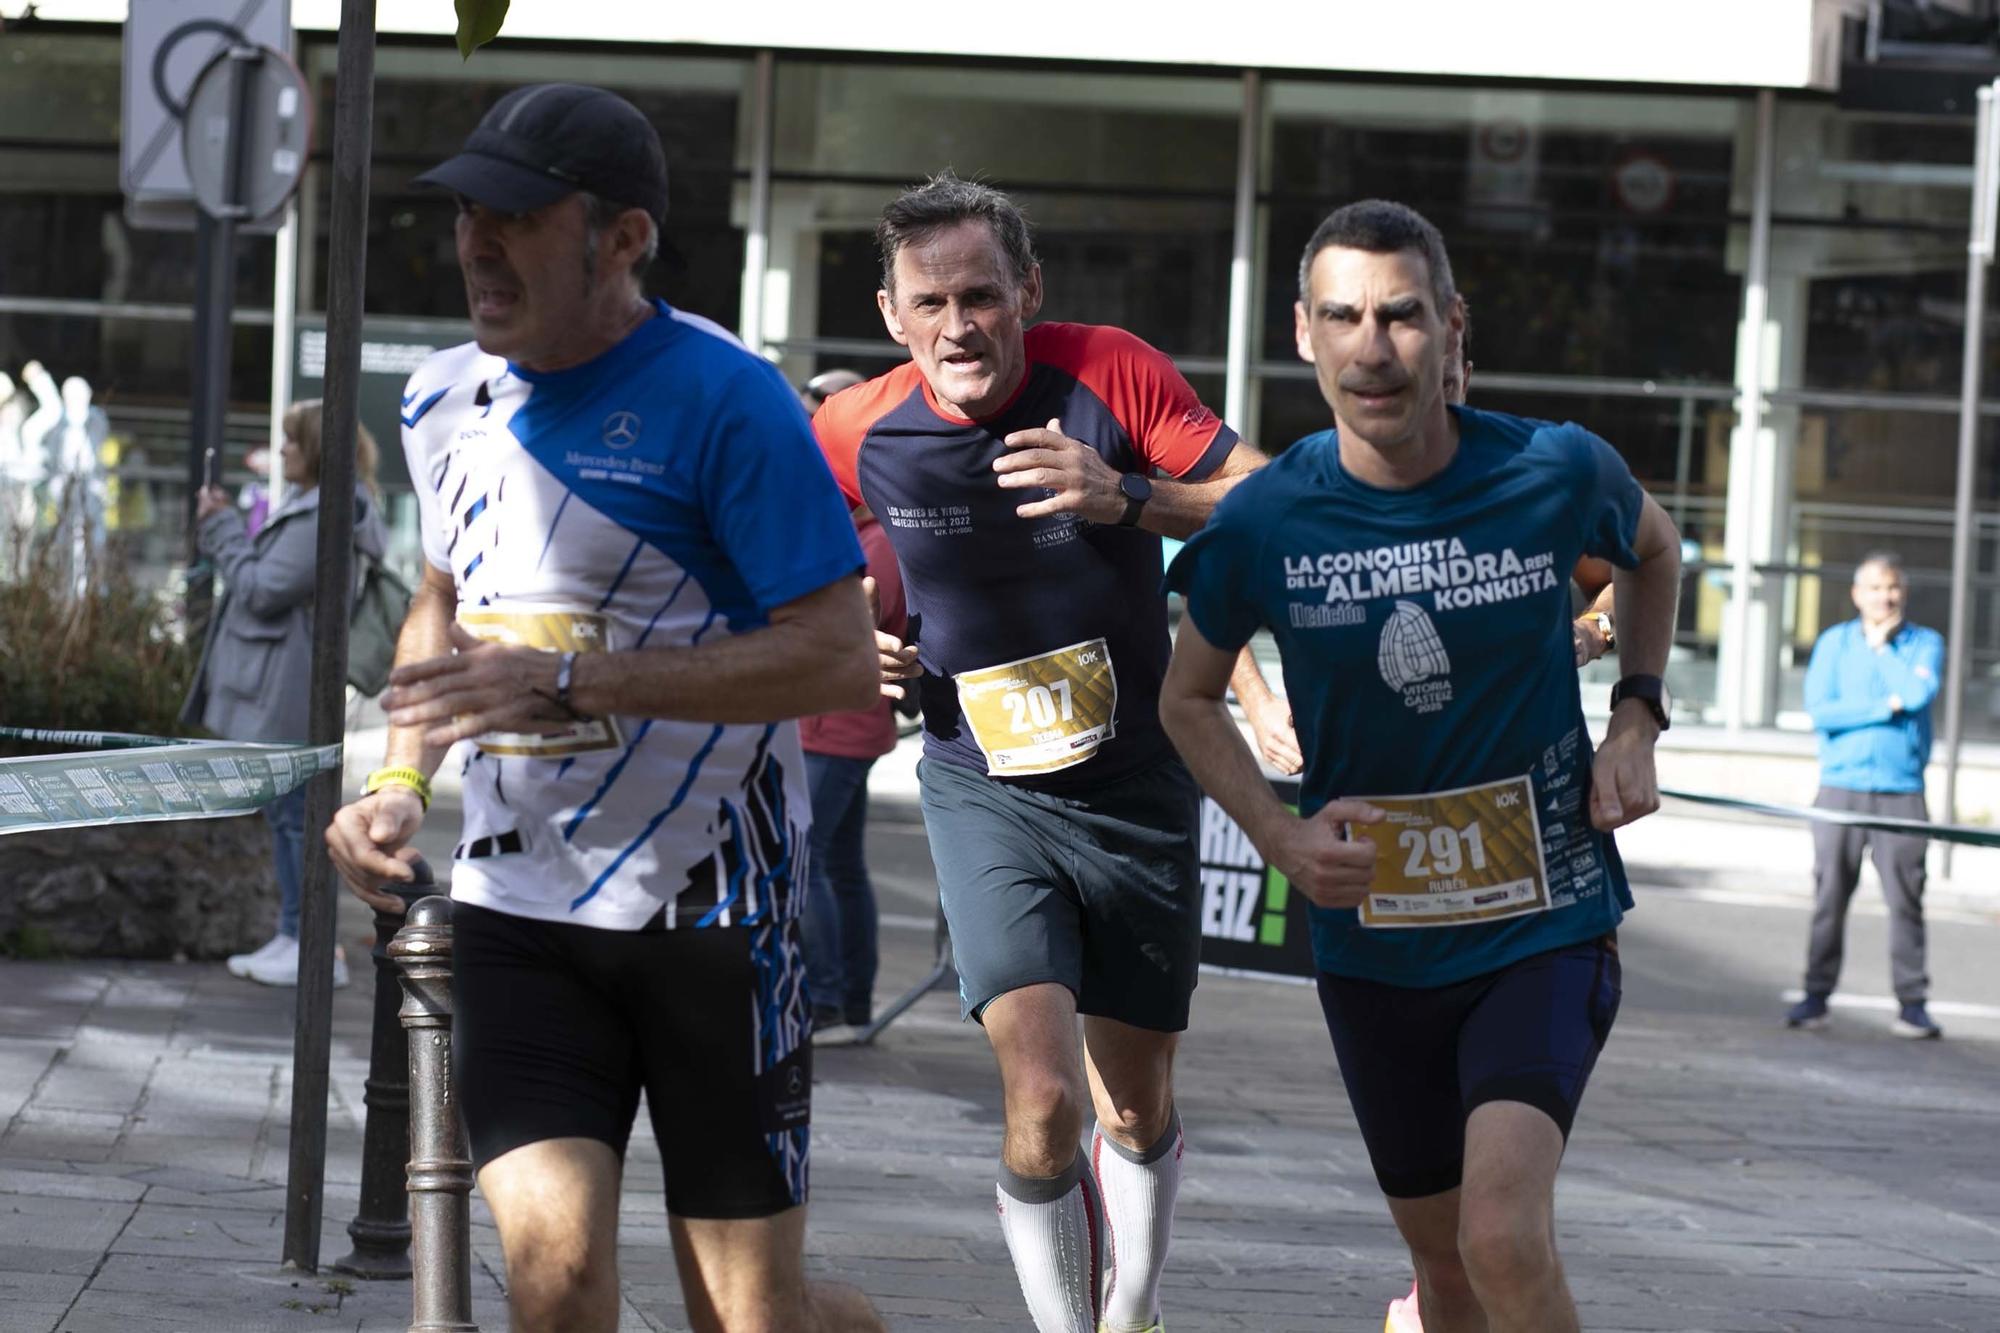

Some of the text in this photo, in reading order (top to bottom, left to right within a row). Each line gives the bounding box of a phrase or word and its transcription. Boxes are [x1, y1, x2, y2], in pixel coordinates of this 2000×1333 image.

[950, 516, 970, 527] 2022
[1284, 537, 1467, 576] LA CONQUISTA
[1286, 548, 1554, 604] DE LA ALMENDRA REN
[1434, 568, 1559, 612] KONKISTA
[1077, 650, 1099, 666] 10K
[1403, 680, 1452, 696] VITORIA
[1404, 690, 1454, 707] GASTEIZ
[1002, 678, 1074, 734] 207
[1496, 790, 1520, 809] 10K
[1398, 821, 1487, 878] 291
